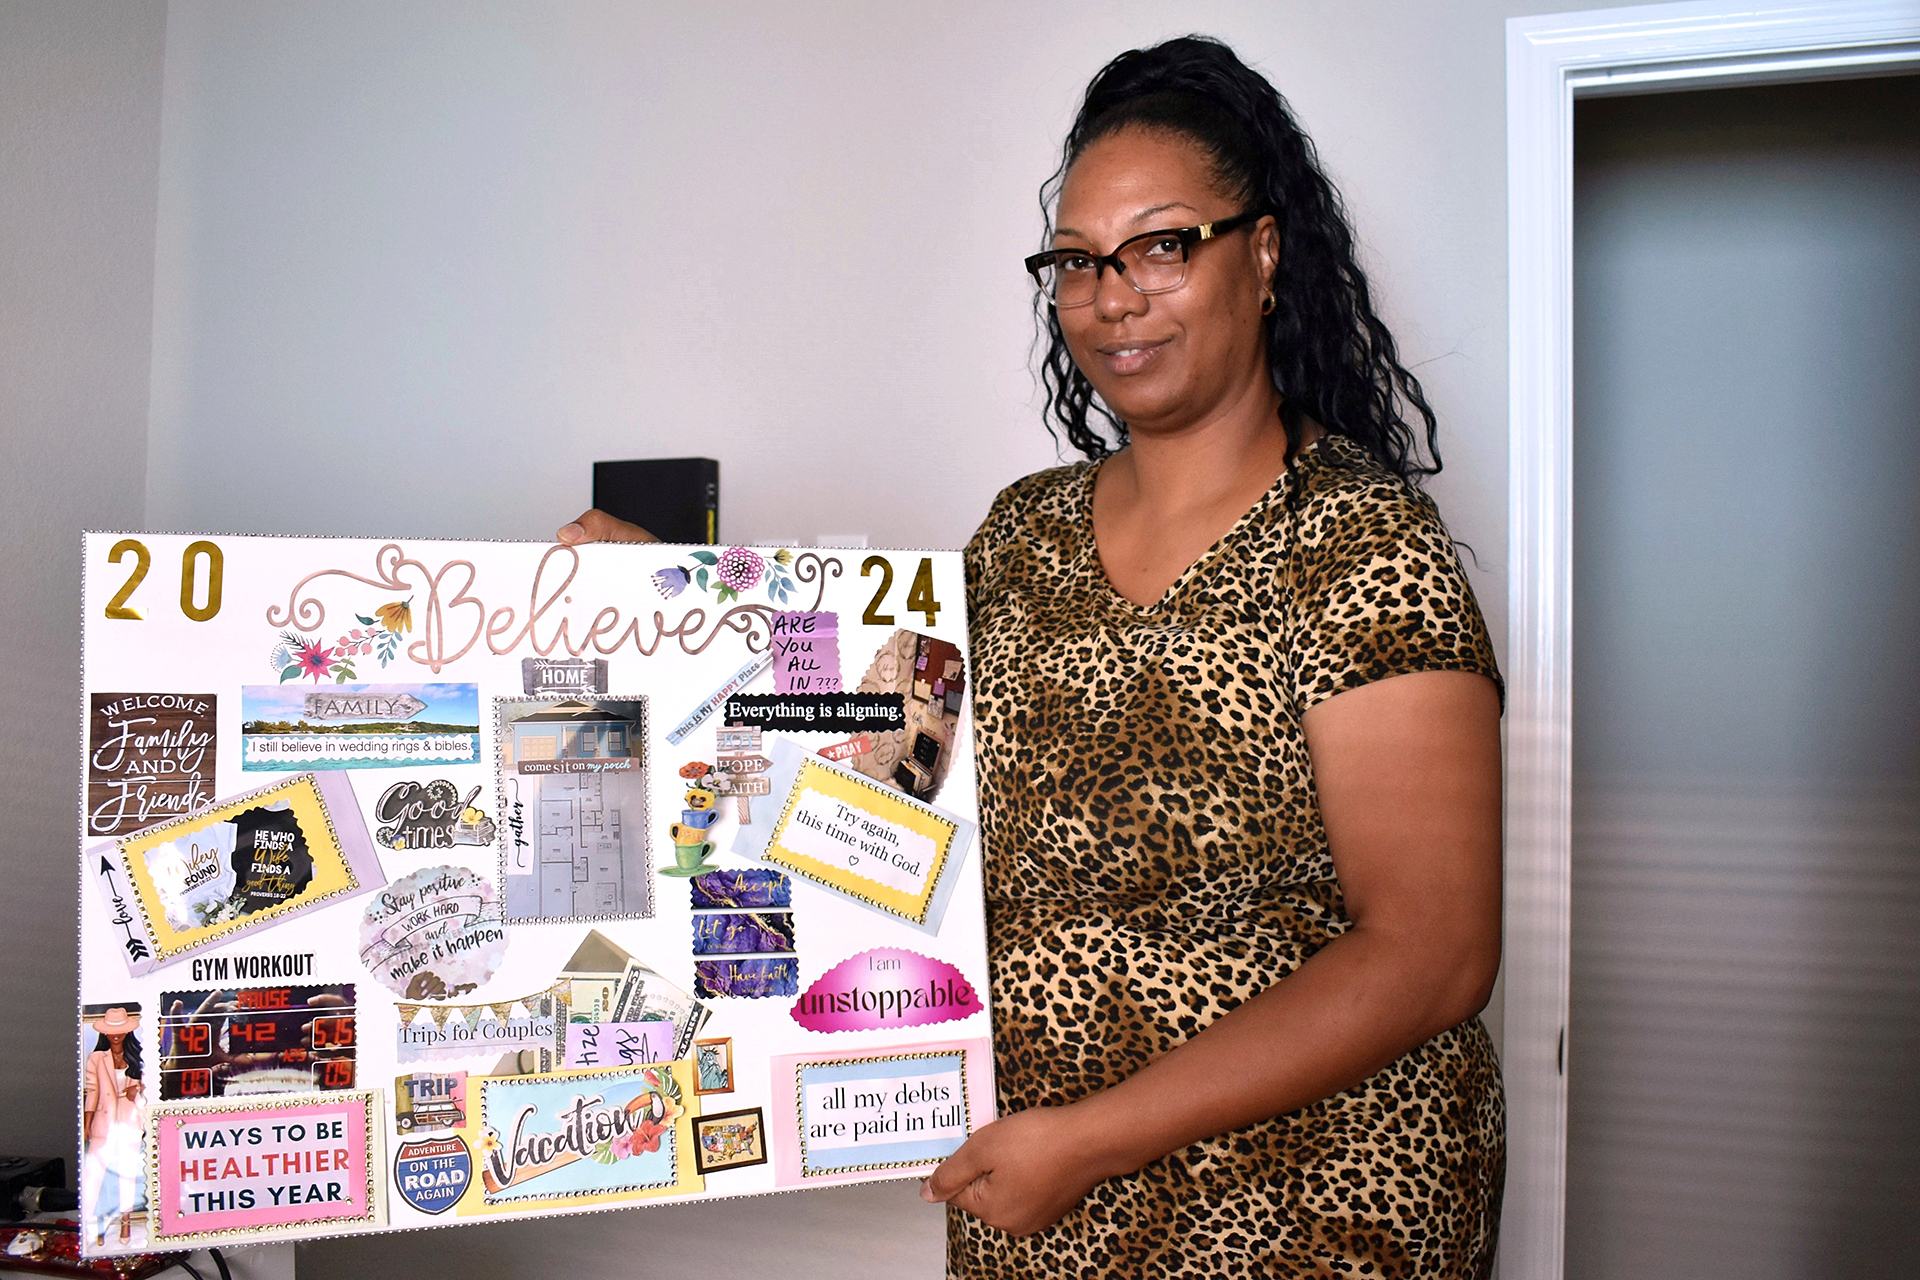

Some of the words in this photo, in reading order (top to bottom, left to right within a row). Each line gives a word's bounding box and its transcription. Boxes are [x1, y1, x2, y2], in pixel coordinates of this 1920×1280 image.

[860, 555, 941, 627] 24
[408, 544, 722, 673] Believe
[773, 615, 816, 636] ARE
[542, 669, 589, 685] HOME
[790, 675, 811, 691] IN
[100, 695, 209, 718] WELCOME
[314, 699, 399, 715] FAMILY
[675, 721, 695, 738] This
[710, 679, 739, 706] HAPPY
[737, 662, 760, 681] Place
[729, 703, 815, 722] Everything
[819, 703, 832, 718] is
[836, 702, 903, 722] aligning.
[92, 717, 215, 773] Family
[259, 741, 278, 752] still
[281, 741, 322, 752] believe
[326, 741, 336, 752] in
[339, 741, 388, 754] wedding
[391, 741, 420, 754] rings
[424, 741, 432, 751] &
[434, 740, 472, 751] bibles.
[717, 732, 756, 749] JOY
[834, 740, 863, 759] PRAY
[125, 759, 176, 774] AND
[524, 763, 552, 772] come
[553, 761, 571, 773] sit
[573, 762, 586, 771] on
[586, 762, 602, 773] my
[601, 759, 632, 773] porch
[718, 760, 765, 773] HOPE
[91, 772, 215, 833] Friends
[376, 782, 482, 836] Good
[509, 798, 529, 850] gather
[836, 804, 861, 828] Try
[860, 817, 900, 847] again,
[254, 840, 284, 850] FINDS
[286, 842, 294, 852] A
[255, 830, 269, 840] HE
[270, 831, 295, 843] WHO
[403, 827, 455, 849] times
[796, 809, 822, 831] this
[825, 824, 858, 847] time
[859, 839, 889, 863] with
[891, 854, 921, 878] God.
[184, 864, 217, 887] FOUND
[251, 862, 283, 875] FINDS
[284, 865, 291, 875] A
[381, 893, 415, 915] Stay
[419, 873, 466, 902] positive
[732, 873, 786, 900] Accept
[401, 910, 431, 932] WORK
[433, 903, 459, 917] HARD
[698, 919, 722, 940] Let
[390, 952, 429, 980] make
[432, 945, 444, 961] it
[446, 929, 504, 955] happen
[876, 957, 901, 970] am
[192, 958, 228, 981] GYM
[233, 953, 314, 979] WORKOUT
[237, 989, 292, 1011] PAUSE
[800, 978, 970, 1019] unstoppable
[180, 1025, 209, 1053] 42
[231, 1022, 276, 1042] 42
[400, 1024, 447, 1045] Trips
[452, 1021, 479, 1041] for
[482, 1019, 553, 1044] Couples
[404, 1077, 458, 1098] TRIP
[823, 1087, 846, 1110] all
[854, 1092, 888, 1113] my
[895, 1081, 950, 1105] debts
[184, 1127, 262, 1149] WAYS
[272, 1124, 306, 1143] TO
[316, 1121, 343, 1140] BE
[810, 1121, 846, 1138] are
[854, 1111, 898, 1142] paid
[906, 1112, 925, 1132] in
[931, 1105, 962, 1130] full
[408, 1143, 456, 1156] ADVENTURE
[490, 1096, 640, 1187] Vacation
[180, 1149, 350, 1182] HEALTHIER
[409, 1161, 430, 1173] ON
[433, 1159, 456, 1170] THE
[404, 1169, 466, 1191] ROAD
[189, 1189, 255, 1212] THIS
[267, 1182, 342, 1206] YEAR
[415, 1188, 455, 1201] AGAIN
